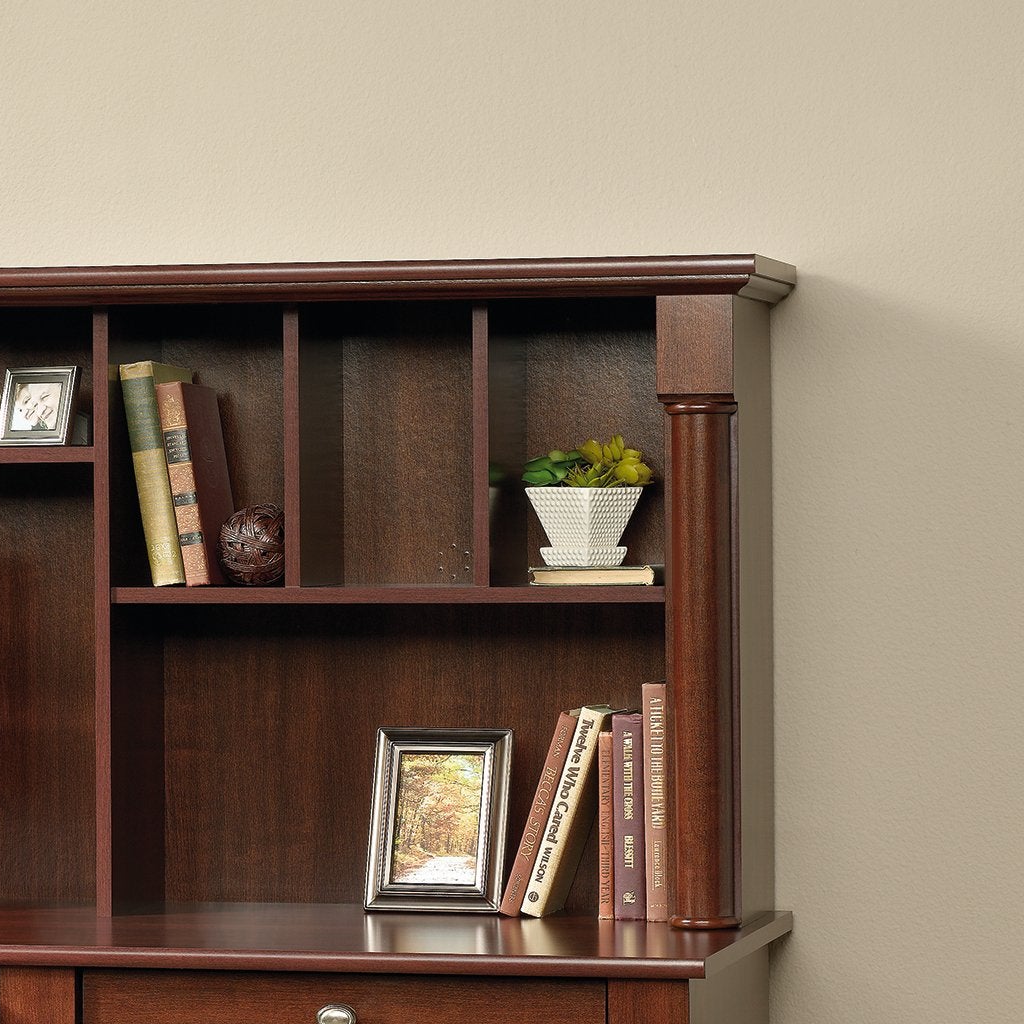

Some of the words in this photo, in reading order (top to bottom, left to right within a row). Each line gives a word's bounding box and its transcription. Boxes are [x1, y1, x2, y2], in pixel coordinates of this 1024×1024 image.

[623, 729, 633, 737] A
[649, 705, 664, 741] TICKET
[553, 725, 568, 758] FORMAN
[570, 719, 595, 764] Twelve
[650, 742, 664, 755] TO
[601, 750, 611, 806] ELEMENTARY
[623, 761, 633, 781] WITH
[650, 756, 664, 774] THE
[560, 766, 580, 800] Who
[623, 781, 633, 797] THE
[546, 801, 569, 844] Cared
[623, 797, 634, 820] CROSS
[520, 816, 541, 862] STORY
[534, 846, 553, 883] WILSON
[600, 880, 611, 904] YEAR
